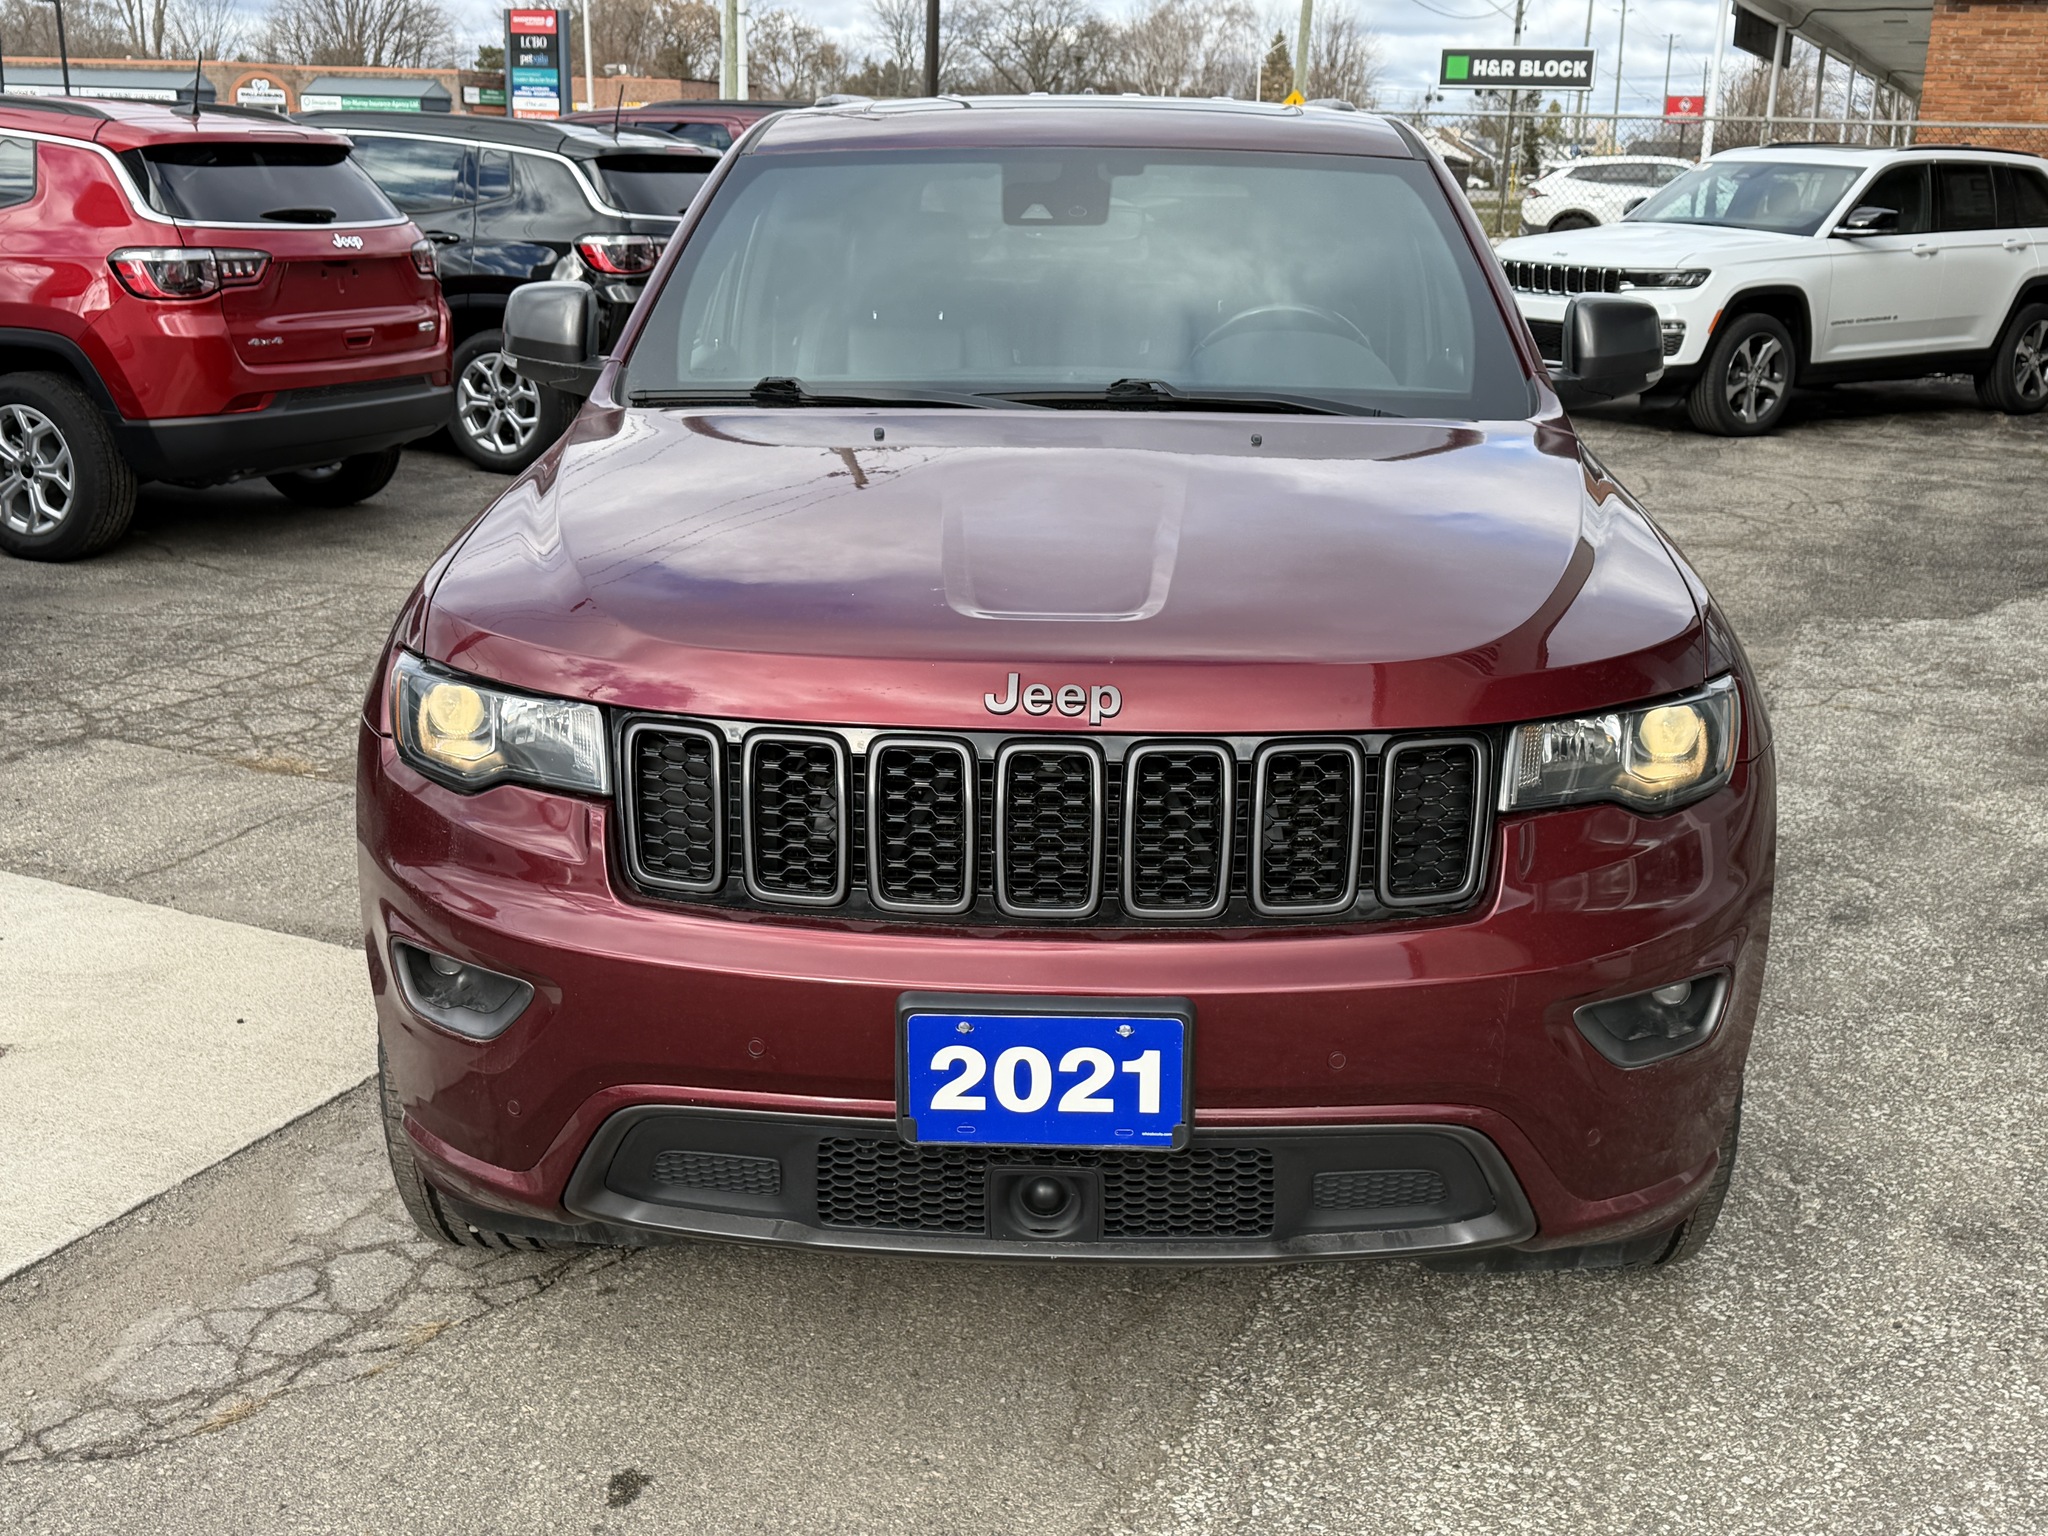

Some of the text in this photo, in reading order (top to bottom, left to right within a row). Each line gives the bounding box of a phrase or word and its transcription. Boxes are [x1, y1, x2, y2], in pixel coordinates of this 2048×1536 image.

[520, 35, 548, 49] LCBO
[1472, 59, 1588, 78] H&R BLOCK
[332, 233, 364, 250] Jeep
[983, 672, 1123, 727] Jeep
[929, 1045, 1161, 1114] 2021
